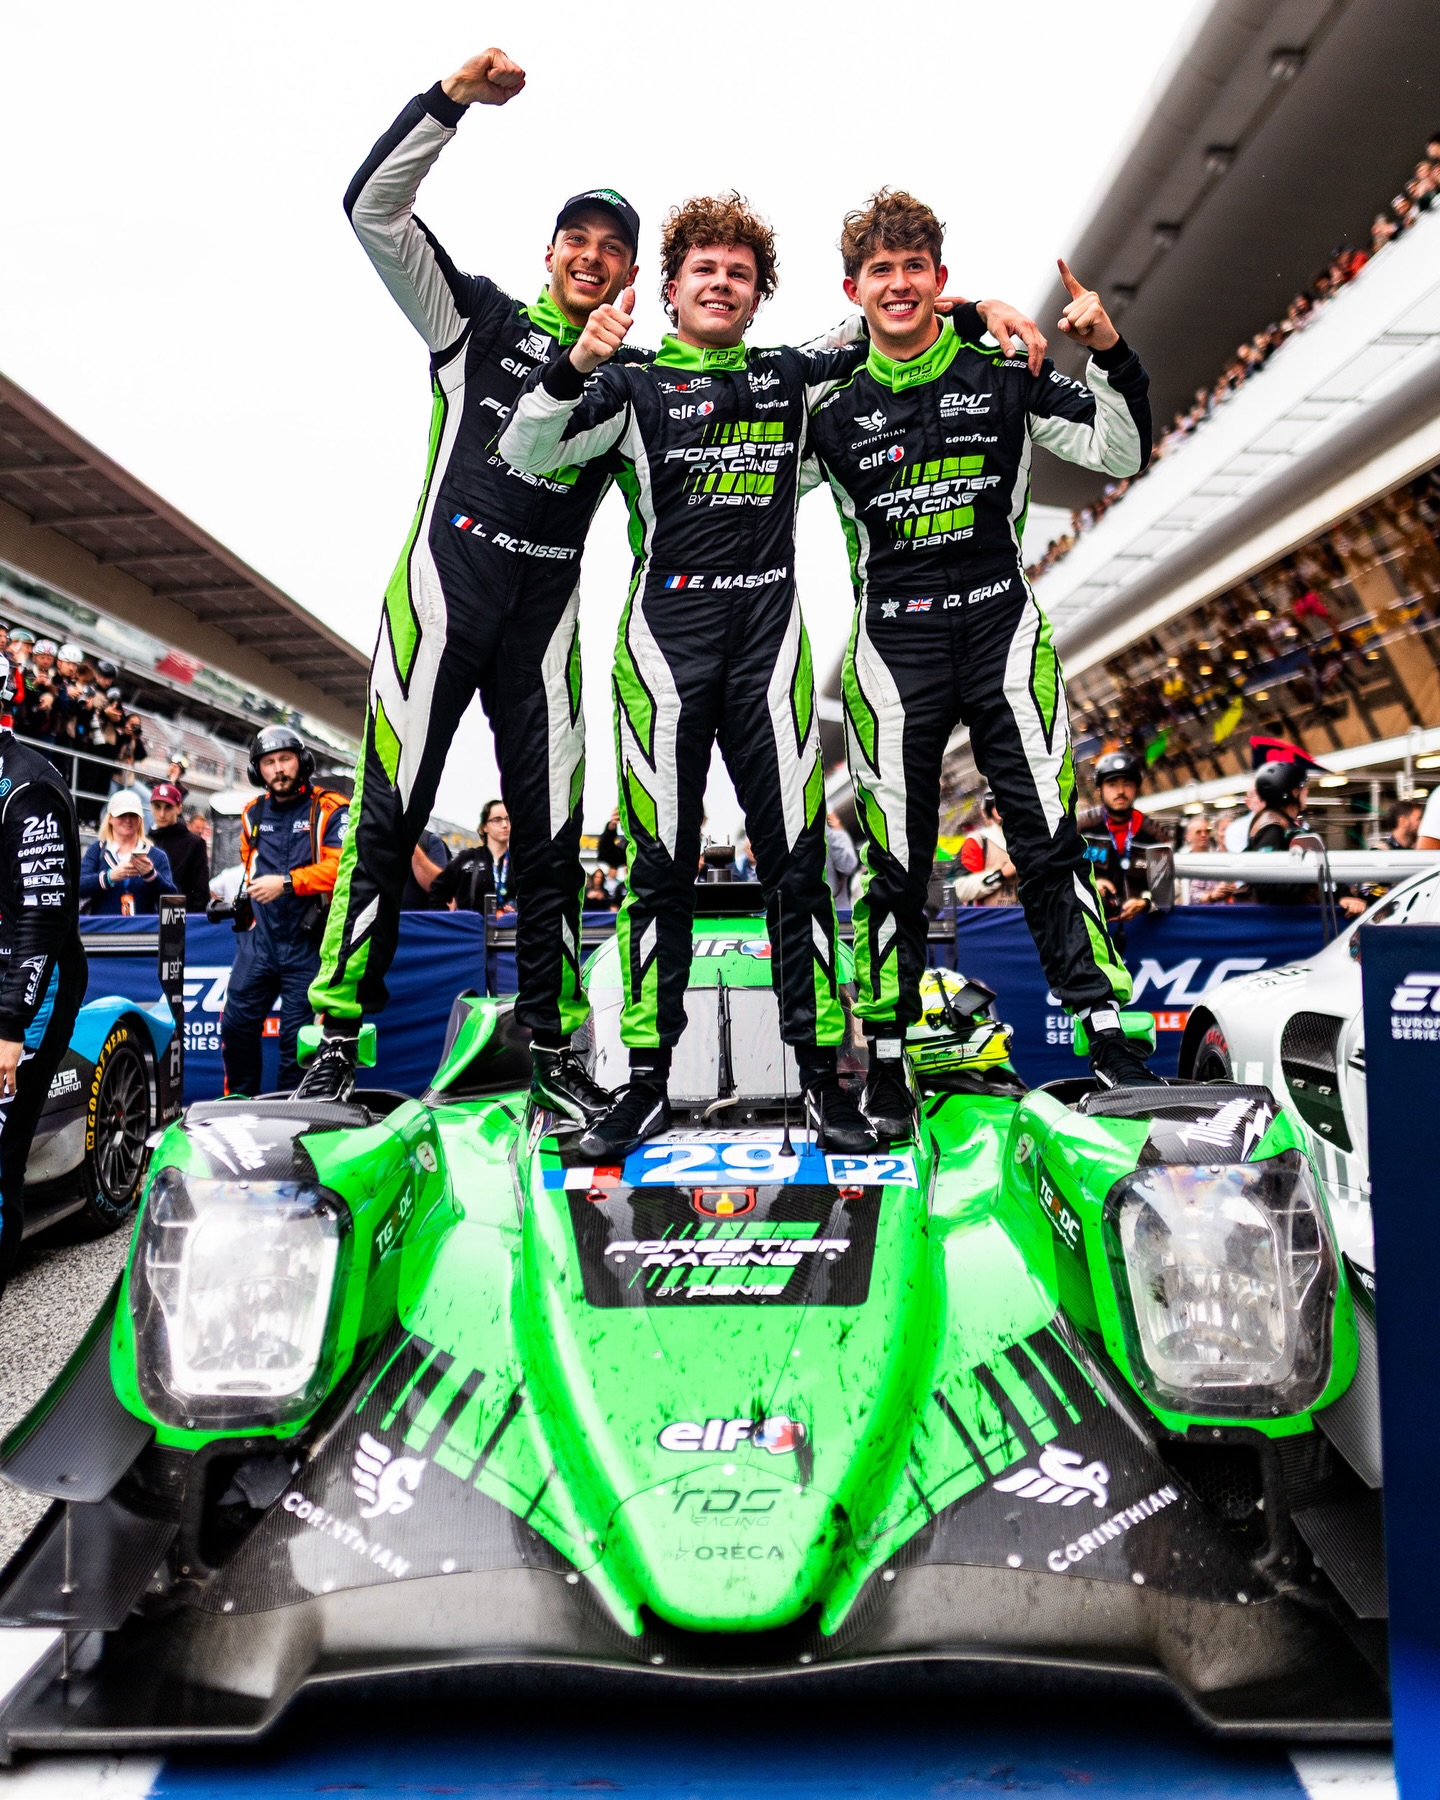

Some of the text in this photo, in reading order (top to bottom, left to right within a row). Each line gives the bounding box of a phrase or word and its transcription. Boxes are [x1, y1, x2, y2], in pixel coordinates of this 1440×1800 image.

[500, 357, 531, 378] elf
[898, 360, 933, 381] TDS
[939, 393, 993, 407] ELMS
[669, 404, 696, 420] elf
[851, 427, 906, 450] CORINTHIAN
[945, 433, 998, 444] GOODYEAR
[487, 455, 506, 468] BY
[664, 441, 795, 464] FORESTIER
[859, 451, 887, 471] elf
[688, 457, 780, 474] RACING
[688, 494, 704, 506] BY
[865, 475, 1001, 511] FORESTIER
[886, 492, 978, 521] RACING
[471, 523, 578, 560] L. ROUSSET
[893, 540, 909, 551] BY
[688, 567, 787, 589] E. MASSON
[968, 579, 1012, 605] GRAY
[18, 843, 64, 857] GOODYEAR
[691, 939, 739, 957] lf
[1159, 1014, 1181, 1029] LE
[1391, 1028, 1440, 1041] SERIE
[88, 1028, 128, 1128] GOODYEAR
[641, 1143, 912, 1184] 29 P2
[1040, 1176, 1080, 1242] TGR-DC
[605, 1239, 850, 1256] FORESTIER
[641, 1252, 803, 1268] RACING
[656, 1286, 683, 1297] BY
[659, 1418, 755, 1452] elf
[671, 1488, 783, 1514] TDS
[282, 1491, 410, 1578] CORINTHIAN
[1048, 1484, 1180, 1572] CORINTHIAN
[694, 1545, 785, 1561] ORECA
